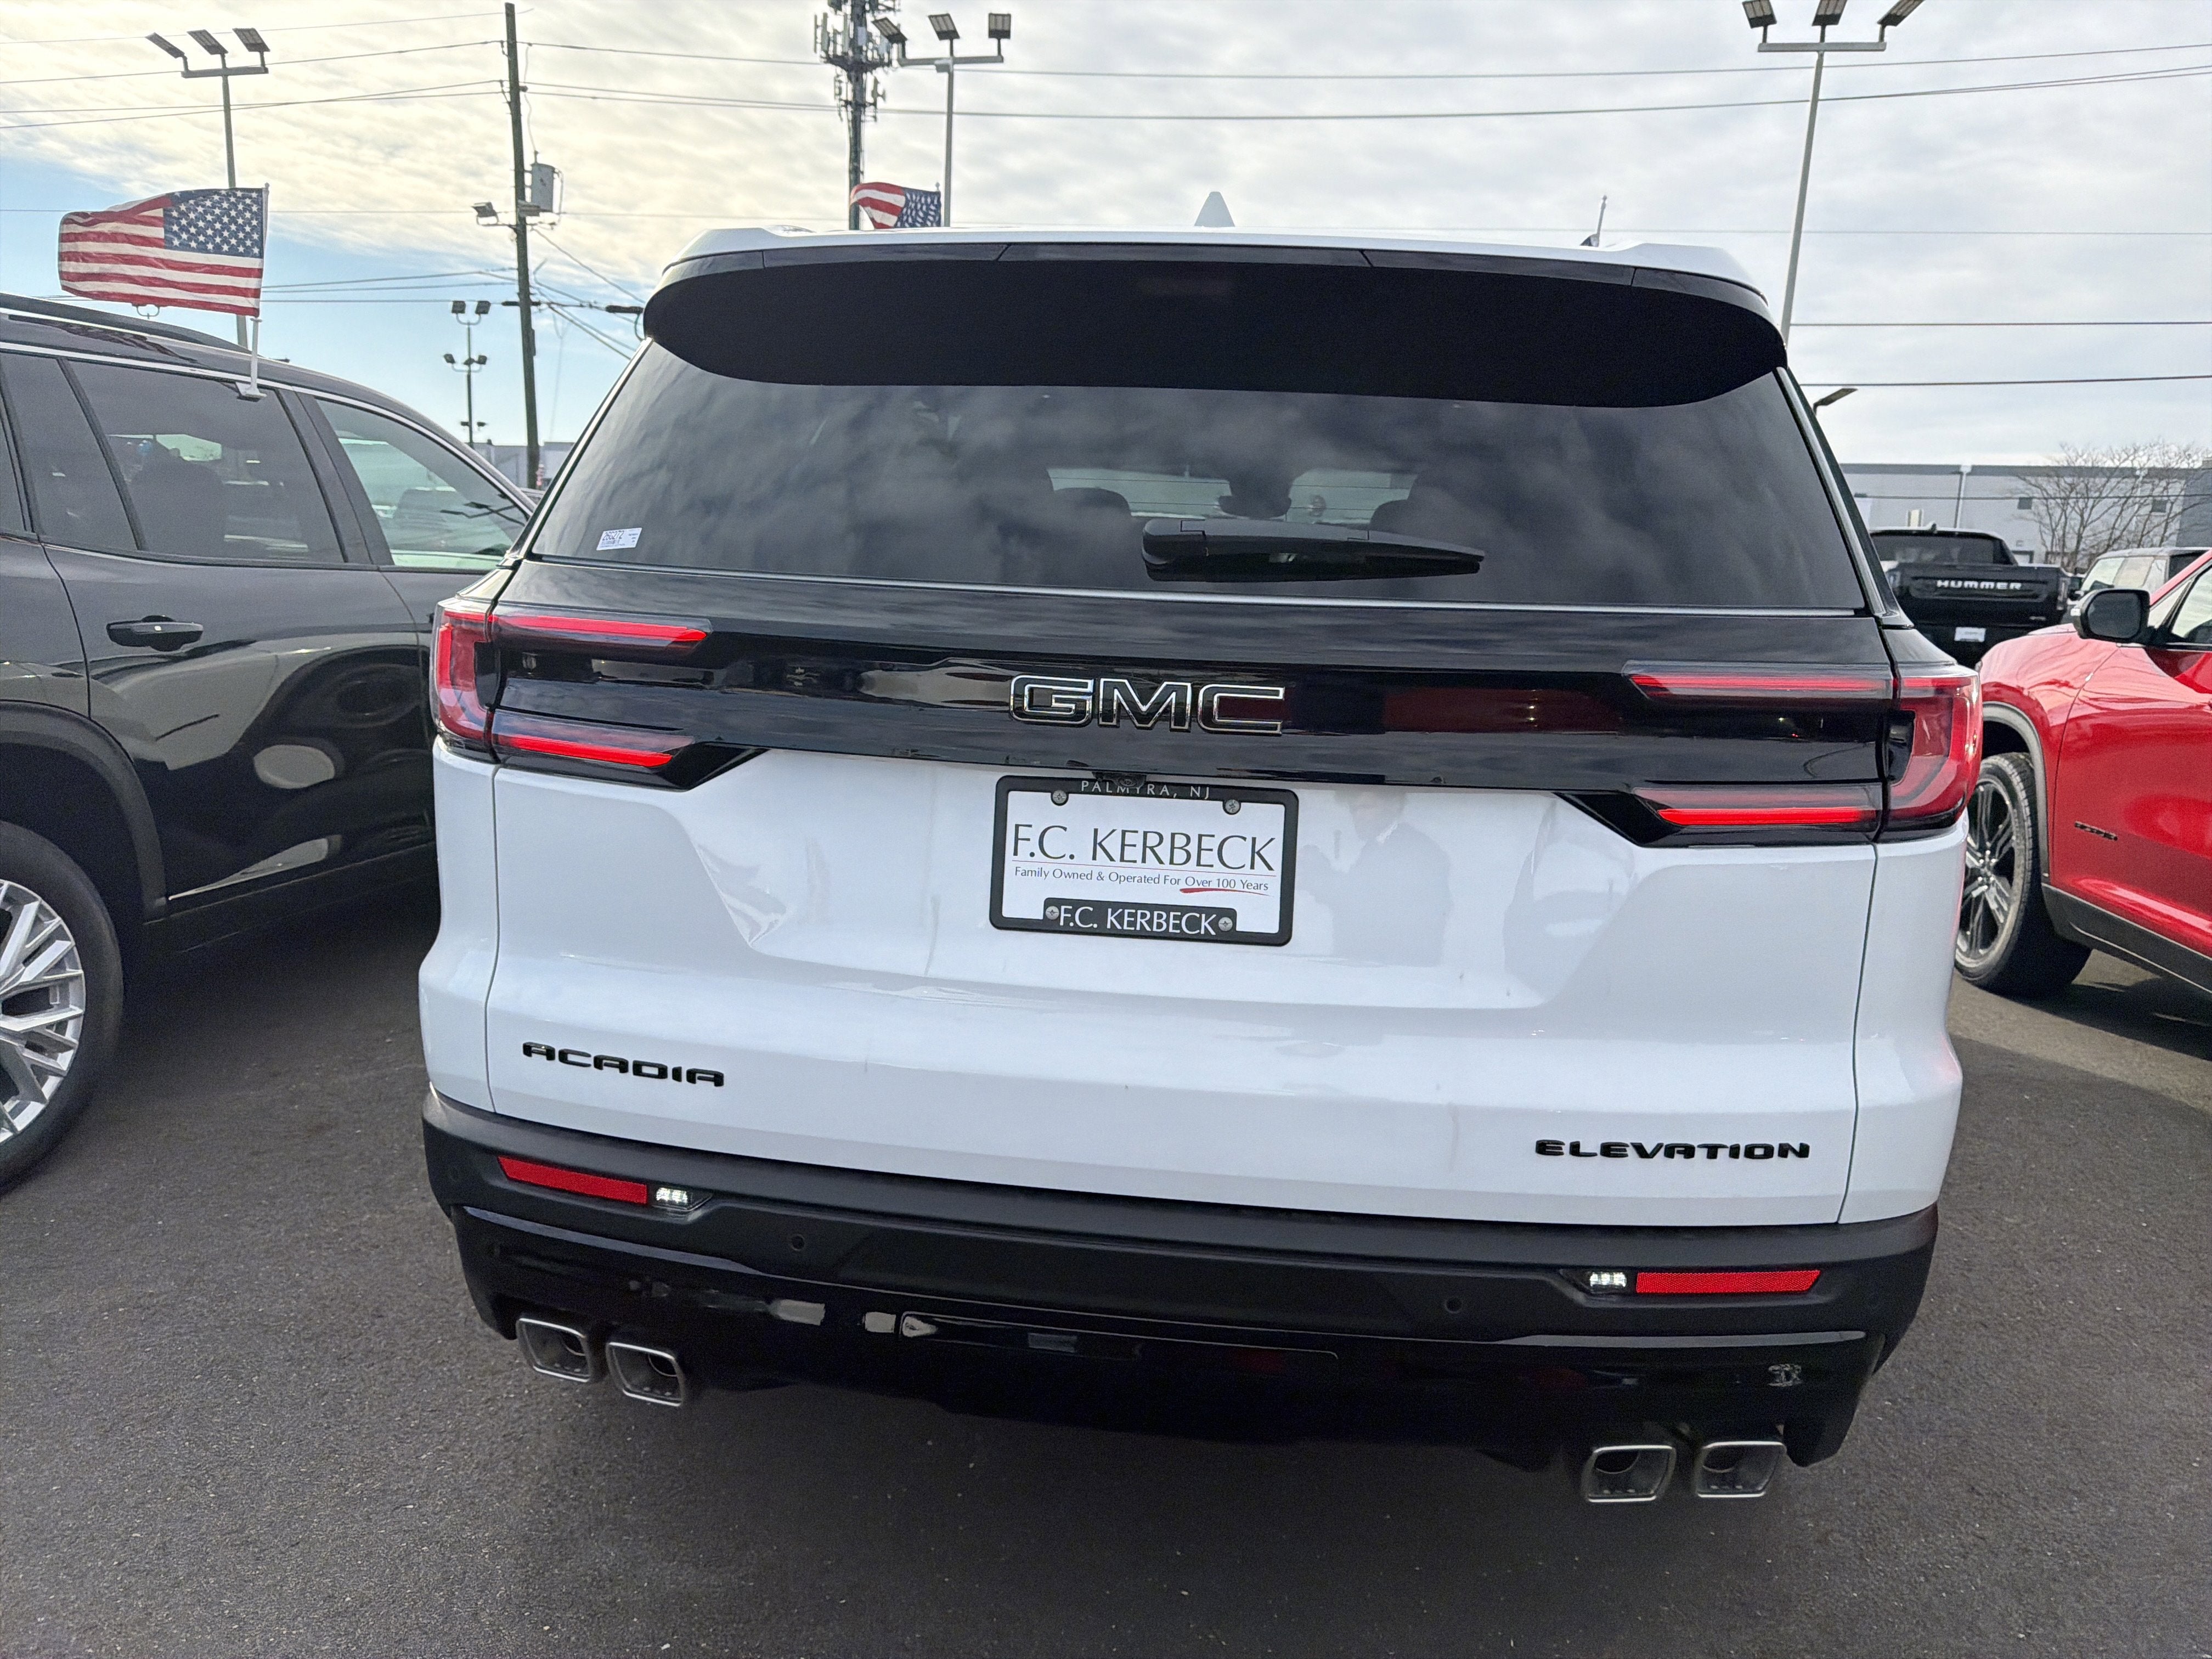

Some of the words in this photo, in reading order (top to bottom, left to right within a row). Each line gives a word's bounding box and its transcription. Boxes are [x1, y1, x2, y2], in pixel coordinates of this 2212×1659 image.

[1937, 579, 2022, 590] HUMMER
[1009, 675, 1285, 736] GMC
[1190, 786, 1210, 799] NJ
[1012, 823, 1075, 860] F.C.
[1092, 827, 1276, 871] KERBECK
[1015, 866, 1049, 880] Family
[1052, 868, 1093, 881] Owned
[1096, 871, 1105, 881] &
[1108, 871, 1160, 885] Operated
[1164, 875, 1181, 885] For
[1185, 876, 1212, 888] Over
[1216, 878, 1237, 889] 100
[1240, 879, 1269, 891] Years
[1059, 905, 1097, 928] F.C.
[1107, 908, 1217, 935] KERBECK
[522, 1041, 724, 1087] ACADIA
[1536, 1139, 1810, 1159] ELEVATION
